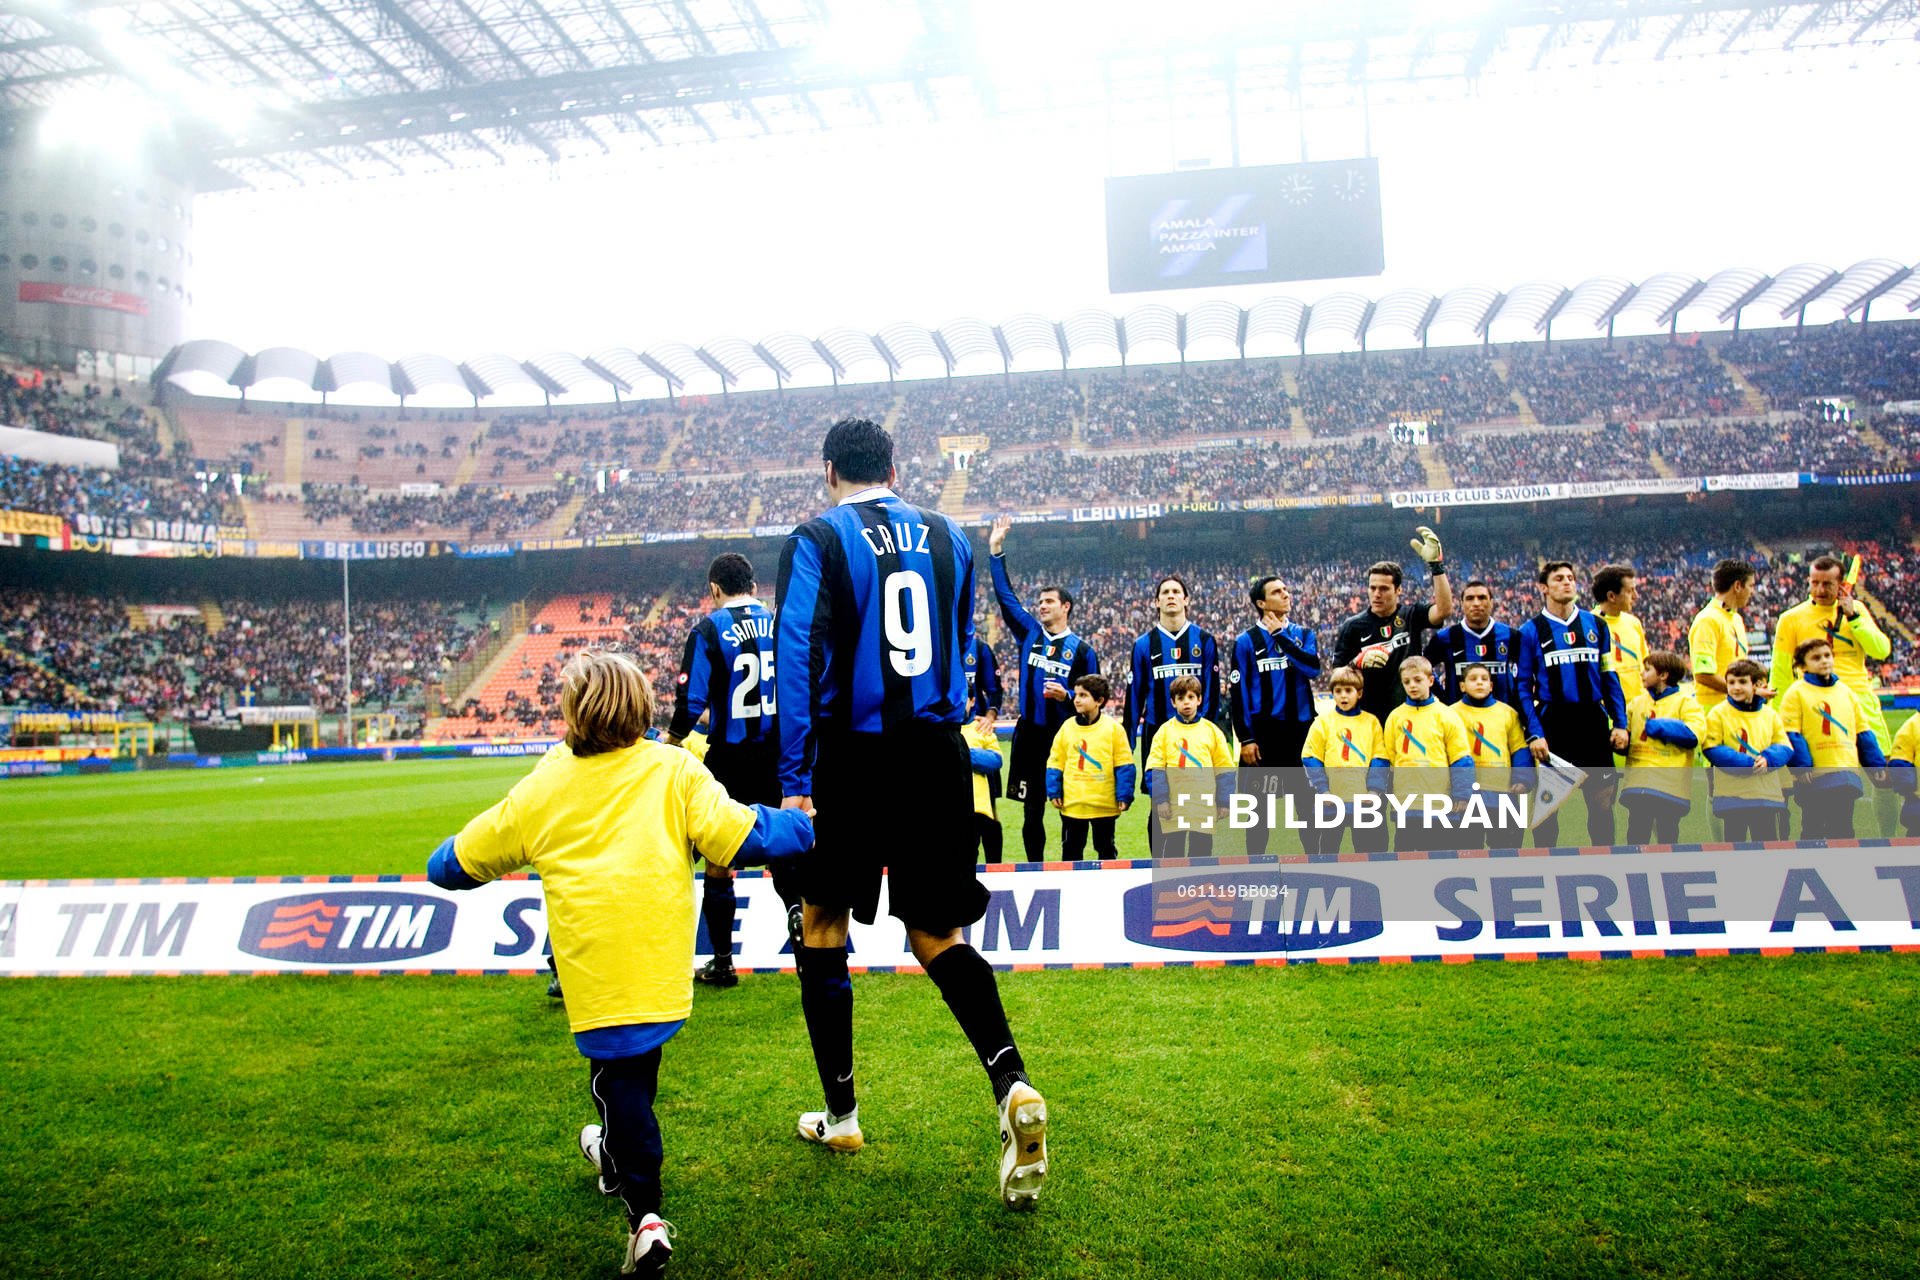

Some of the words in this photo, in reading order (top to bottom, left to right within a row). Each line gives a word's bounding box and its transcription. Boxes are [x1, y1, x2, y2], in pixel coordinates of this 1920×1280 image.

[1159, 217, 1216, 229] AMALA
[1159, 230, 1210, 242] PAZZA
[1214, 226, 1259, 239] INTER
[1159, 241, 1217, 254] AMALA
[1410, 491, 1451, 504] INTER
[1455, 490, 1490, 502] CLUB
[1496, 487, 1551, 500] SAVONA
[861, 522, 930, 556] CRUZ
[323, 541, 426, 559] BELLUSCO
[470, 543, 510, 555] OPERA
[722, 617, 774, 647] SAMU
[884, 570, 933, 677] 9
[1544, 647, 1600, 667] PIRELLI
[1152, 663, 1202, 679] PIRELLI
[731, 650, 776, 719] 25
[471, 746, 499, 756] AMALA
[500, 745, 525, 755] PAZZA
[526, 744, 548, 754] INTER
[1017, 780, 1027, 799] 5
[1262, 775, 1278, 793] 16
[1242, 886, 1351, 936] TIM
[1433, 872, 1726, 942] SERIE
[1769, 868, 1857, 933] A
[56, 902, 199, 958] TIM
[338, 904, 435, 950] TIM
